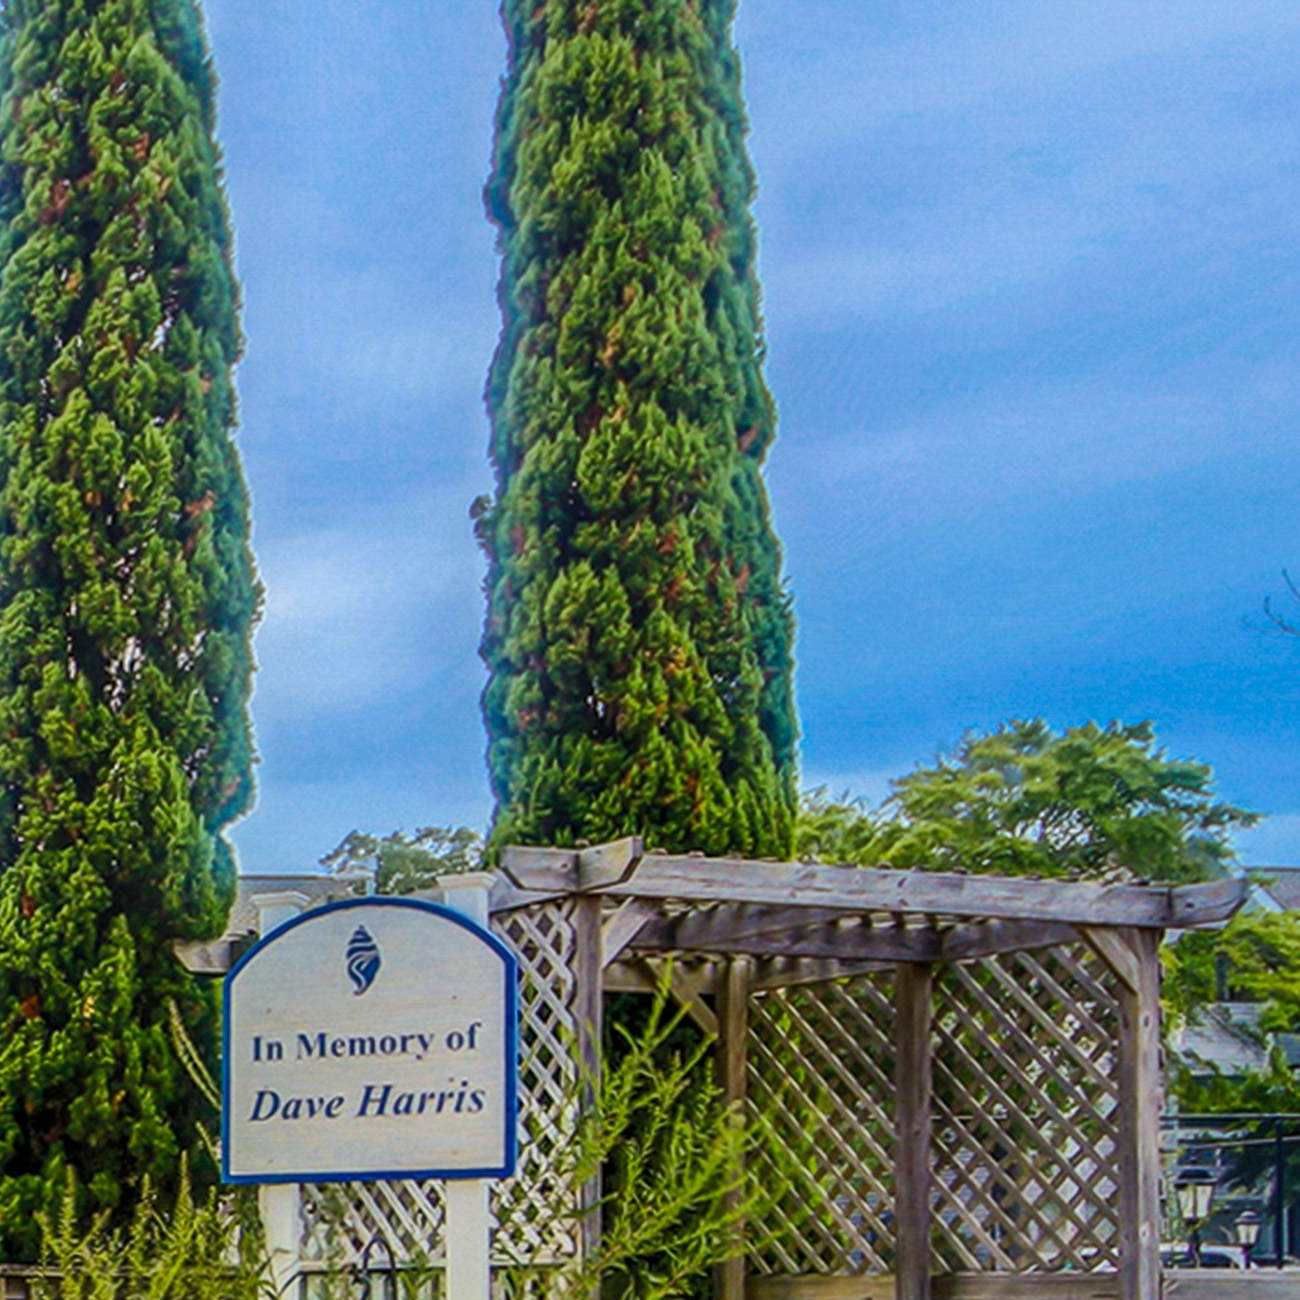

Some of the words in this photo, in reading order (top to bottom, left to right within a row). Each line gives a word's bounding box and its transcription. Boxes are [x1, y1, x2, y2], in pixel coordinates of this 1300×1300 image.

[253, 1035, 284, 1062] In
[296, 1031, 434, 1060] Memory
[446, 1022, 482, 1050] of
[249, 1089, 345, 1122] Dave
[356, 1081, 485, 1117] Harris
